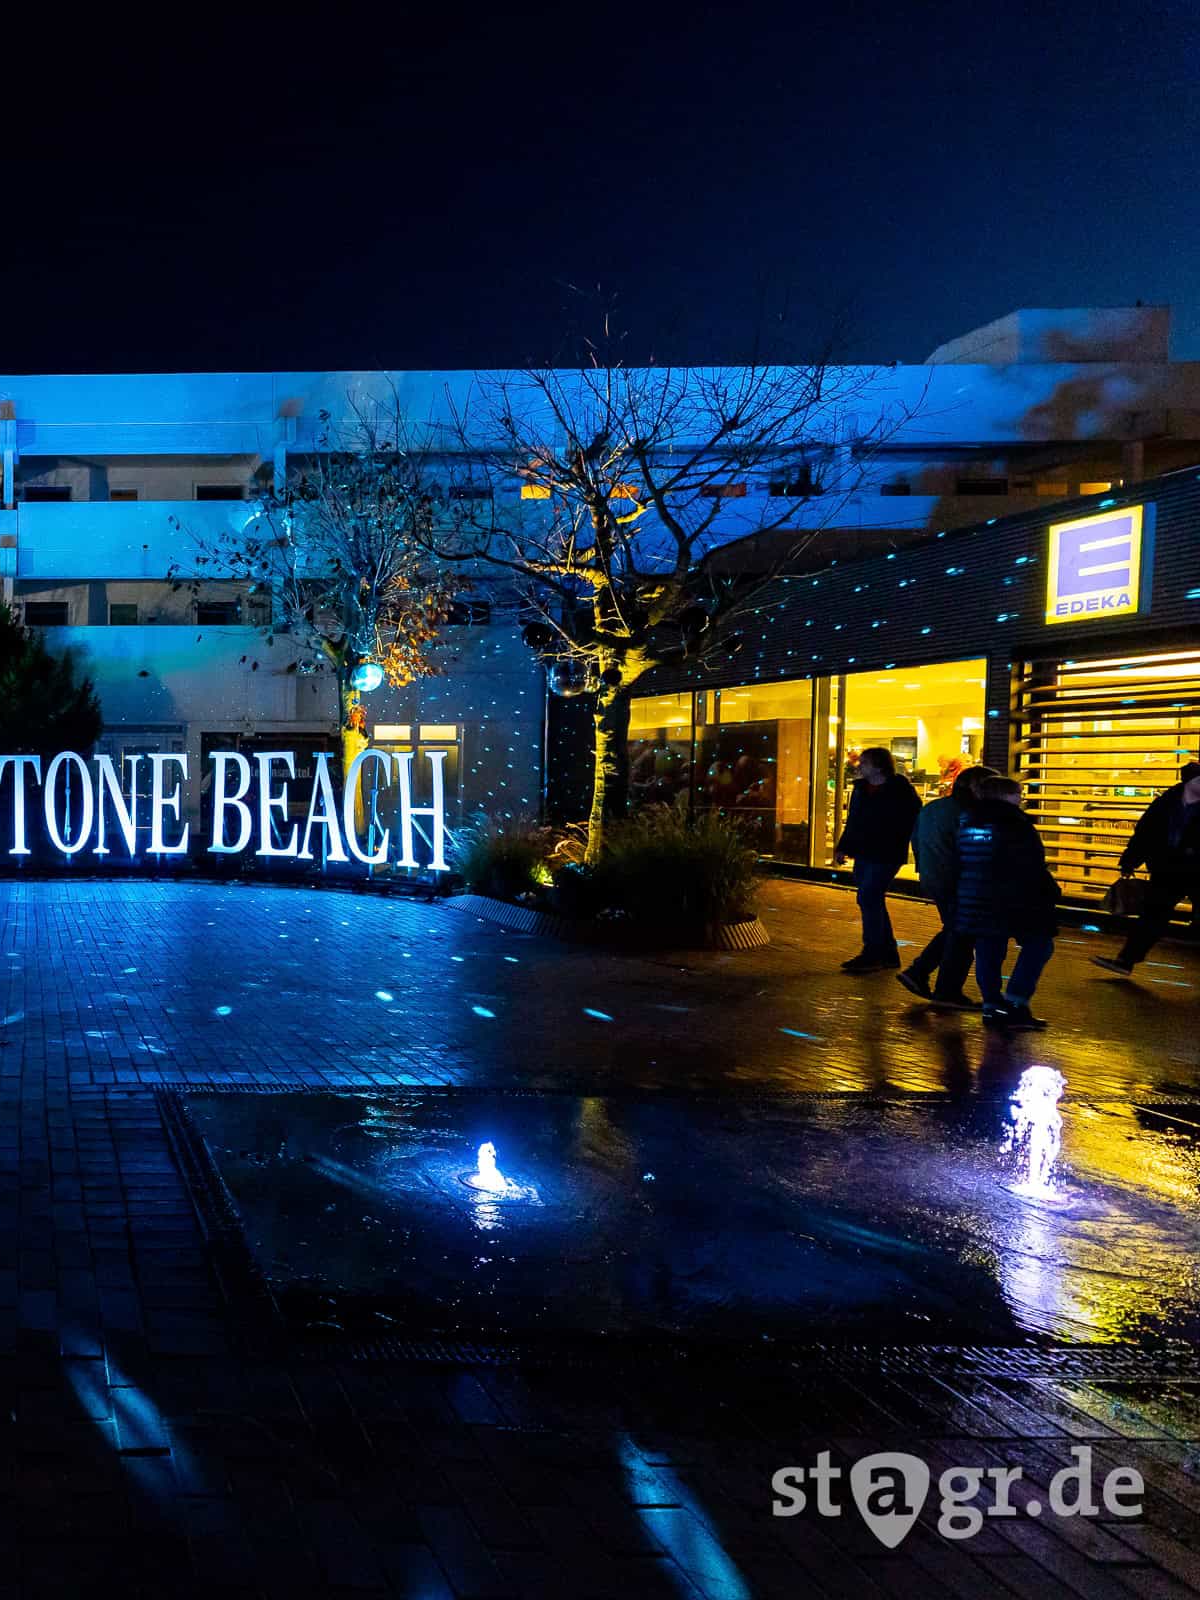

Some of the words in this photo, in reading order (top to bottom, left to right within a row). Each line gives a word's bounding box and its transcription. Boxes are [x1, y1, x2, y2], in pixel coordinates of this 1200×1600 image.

[1057, 516, 1132, 598] E
[1056, 593, 1131, 616] EDEKA
[208, 749, 452, 871] BEACH
